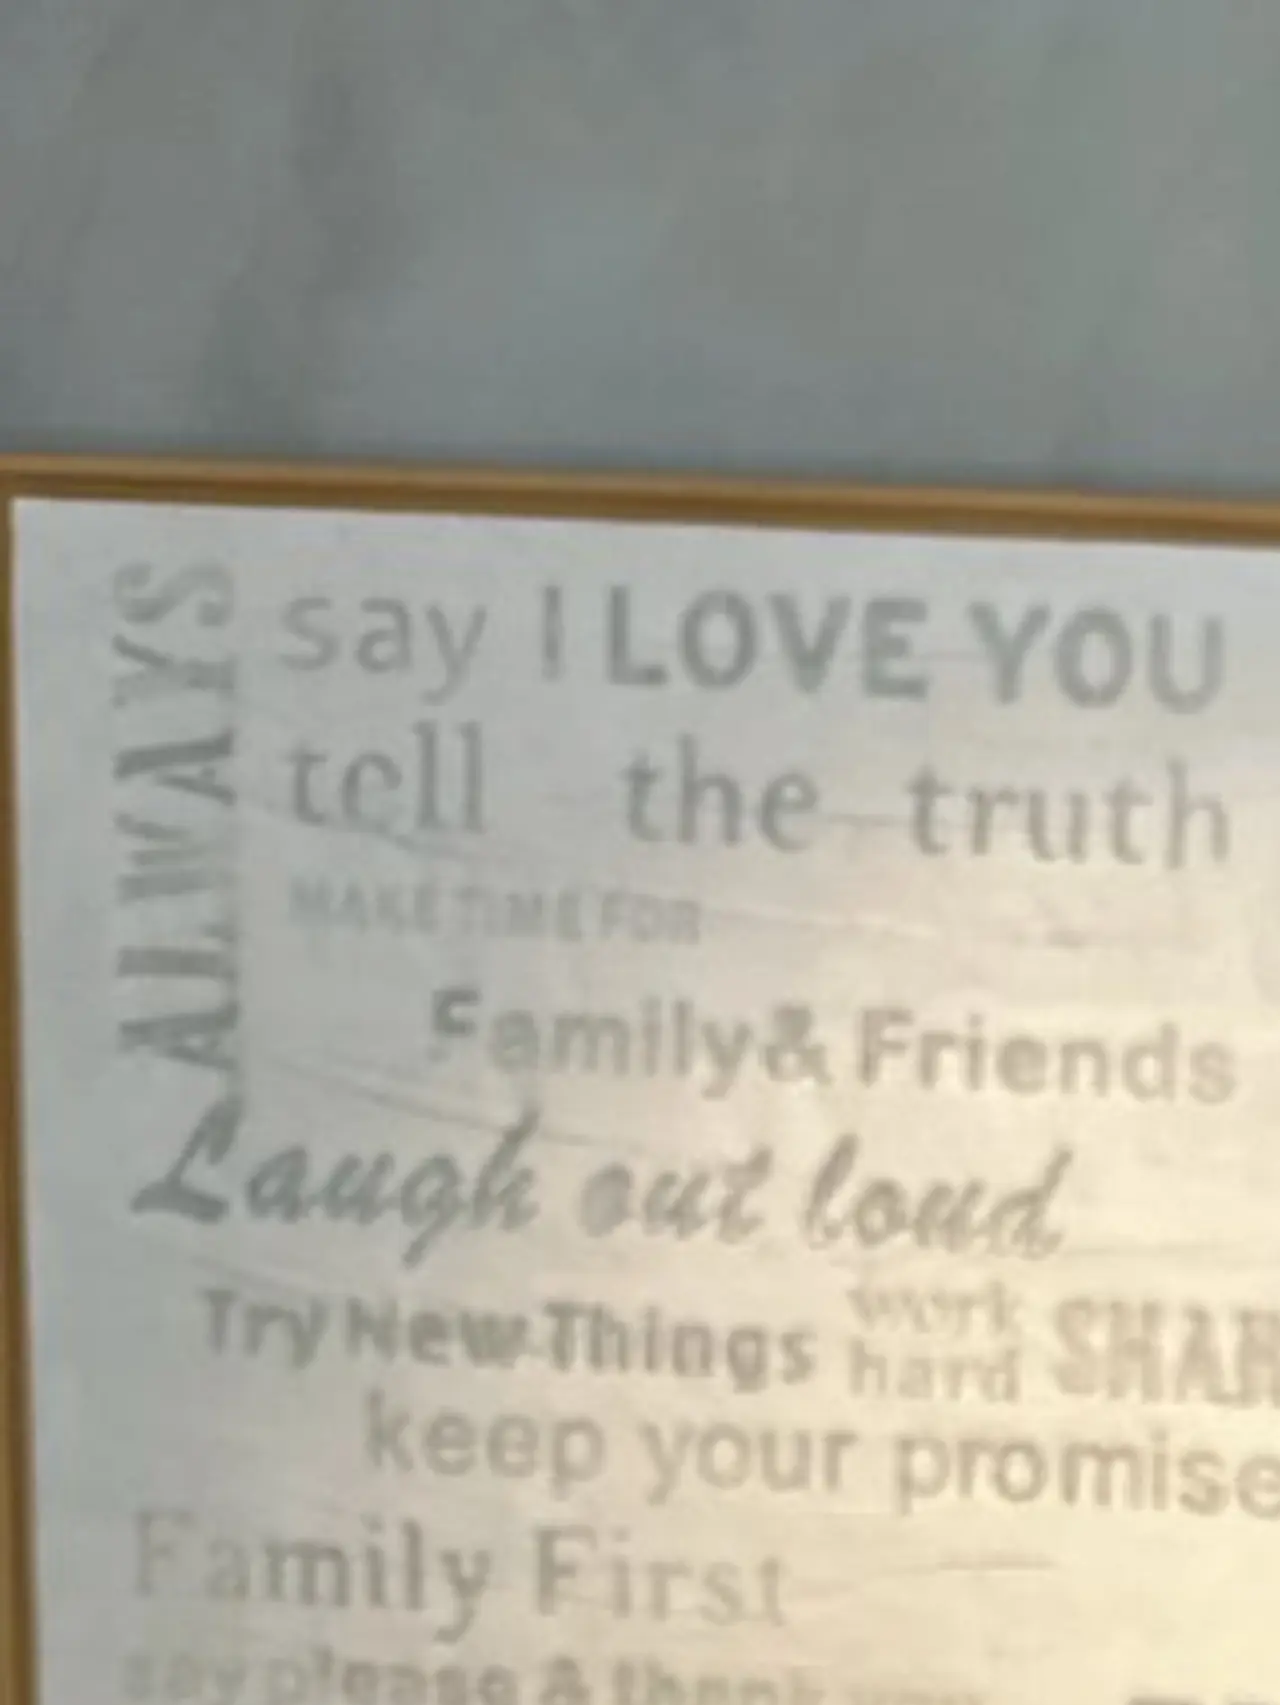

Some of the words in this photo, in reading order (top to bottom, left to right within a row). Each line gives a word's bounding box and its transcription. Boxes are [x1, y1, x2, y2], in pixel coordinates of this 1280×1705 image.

[280, 594, 487, 705] say
[540, 584, 562, 681] I
[606, 584, 931, 700] LOVE
[969, 602, 1225, 715] YOU
[111, 560, 240, 1072] ALWAYS
[287, 720, 487, 835] tell
[622, 733, 821, 853] the
[907, 757, 1232, 871] truth
[860, 1005, 1239, 1105] Friends
[131, 1095, 541, 1267] Laugh
[580, 1146, 772, 1245] out
[804, 1131, 1073, 1261] loud
[202, 1287, 329, 1368] Try
[346, 1295, 528, 1368] New
[541, 1300, 817, 1394] Things
[846, 1337, 1021, 1404] hard
[365, 1389, 608, 1498] keep
[641, 1418, 860, 1508] your
[133, 1508, 492, 1645] Family
[533, 1520, 791, 1629] First
